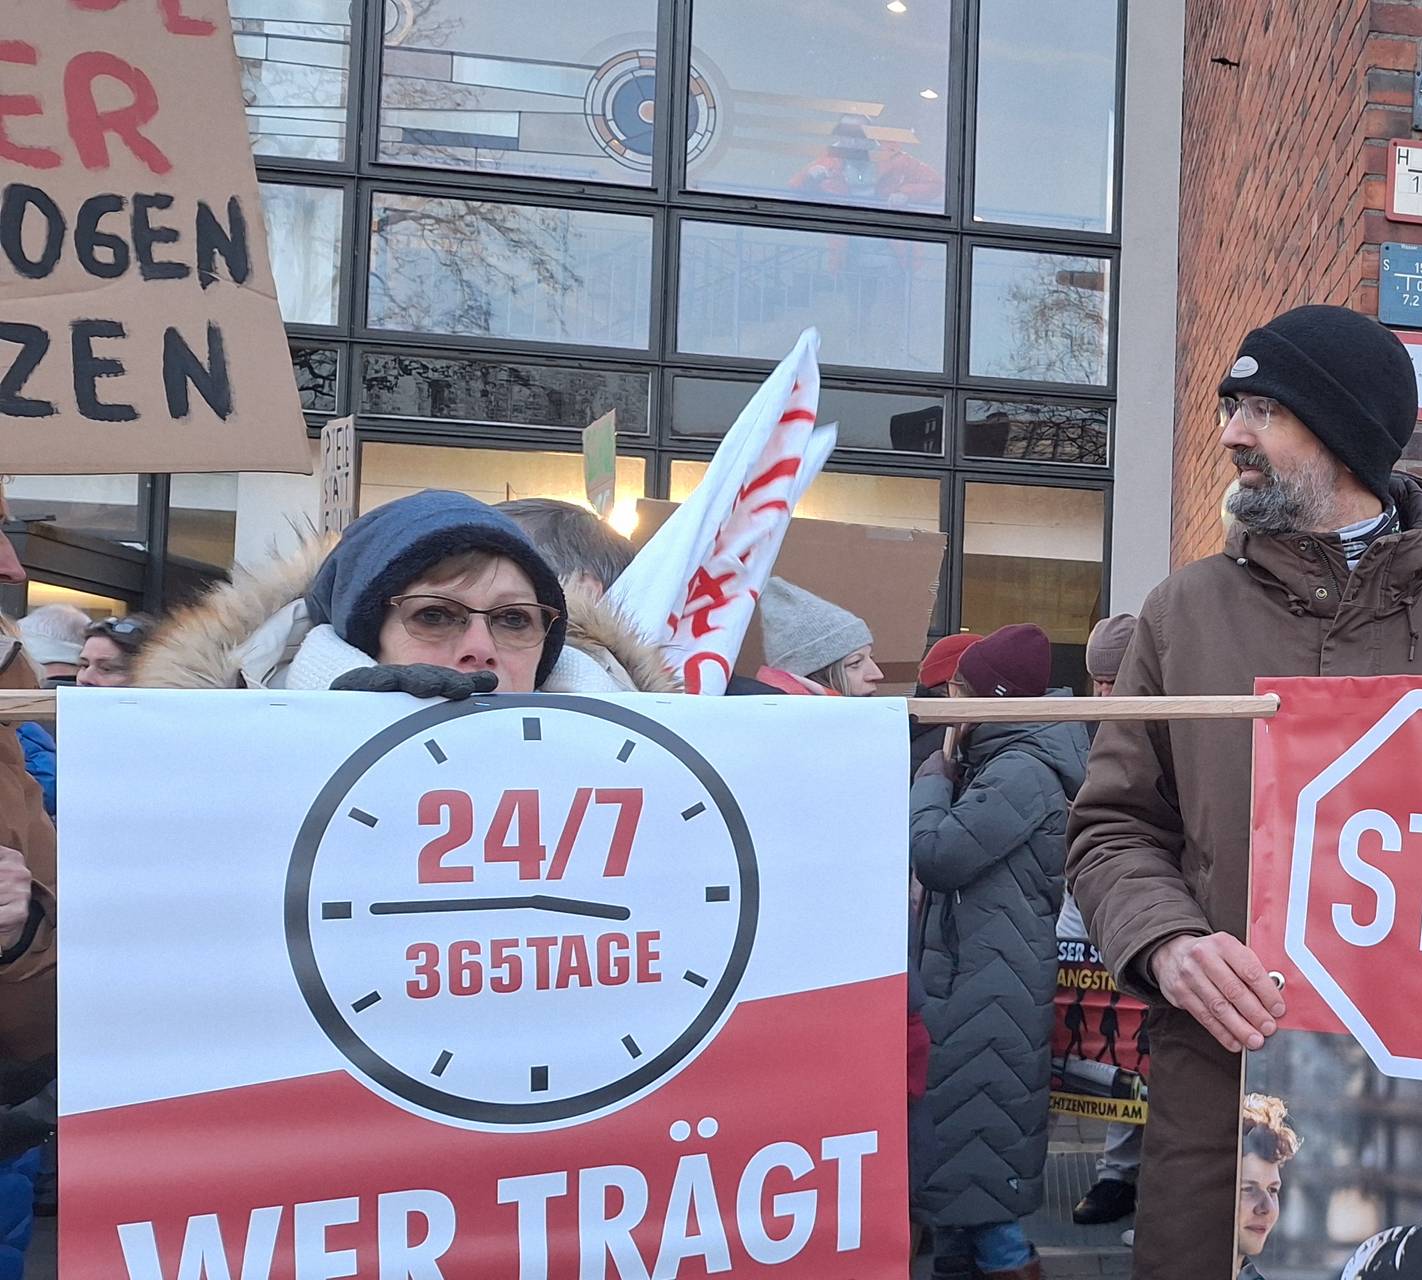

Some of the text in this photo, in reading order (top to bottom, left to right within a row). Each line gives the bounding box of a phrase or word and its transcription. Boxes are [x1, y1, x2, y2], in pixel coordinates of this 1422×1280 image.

[1397, 148, 1409, 166] H
[1383, 259, 1390, 271] S
[417, 787, 644, 884] 24/7
[1056, 941, 1085, 962] SER
[405, 930, 662, 1000] 365TAGE
[1121, 1105, 1143, 1119] AM
[117, 1116, 879, 1280] WER TRÄGT
